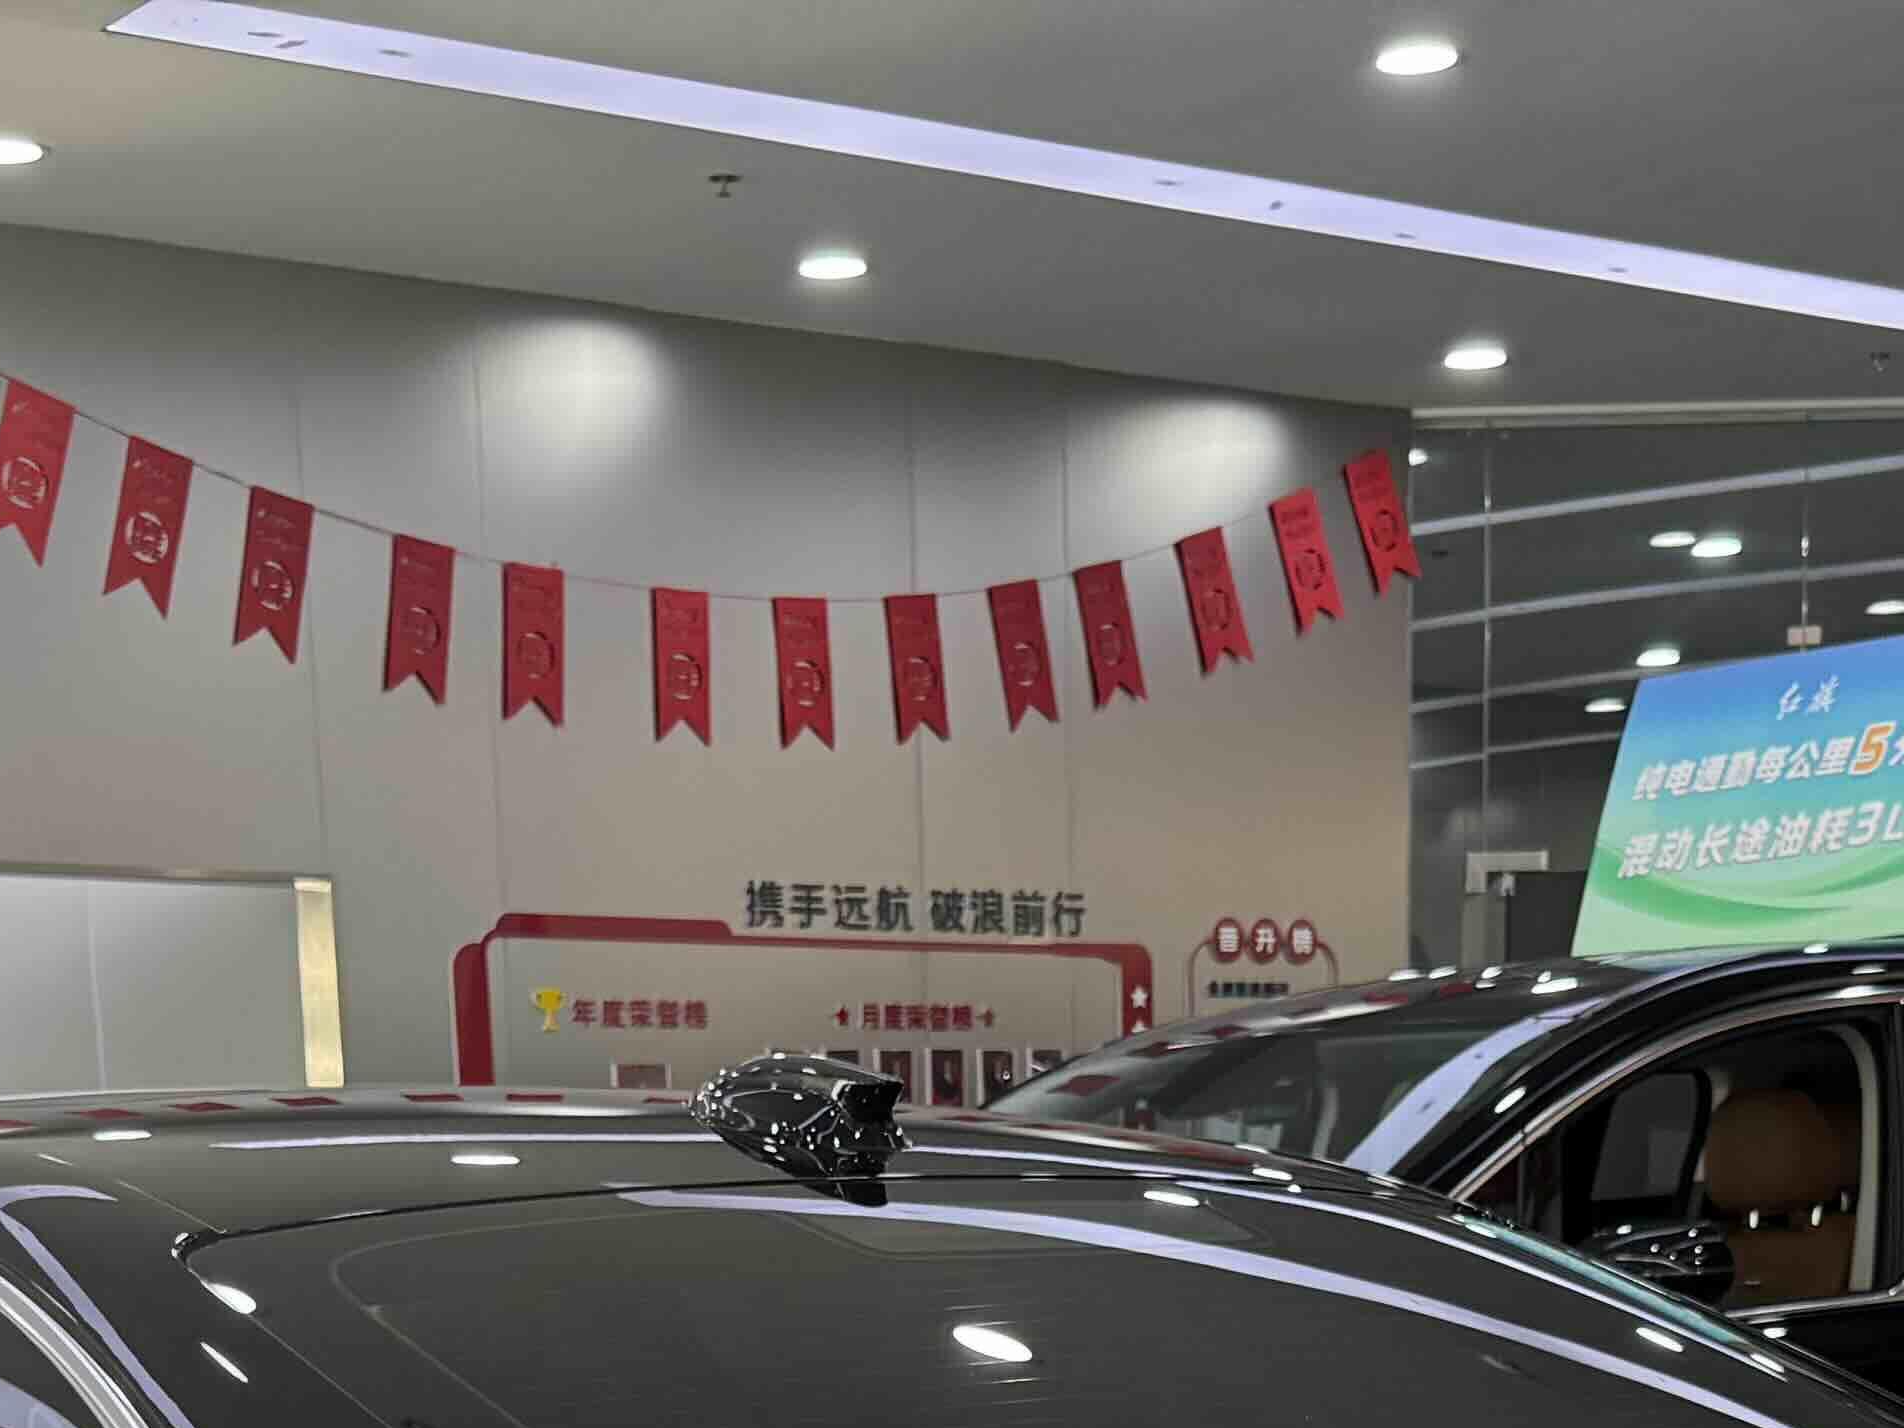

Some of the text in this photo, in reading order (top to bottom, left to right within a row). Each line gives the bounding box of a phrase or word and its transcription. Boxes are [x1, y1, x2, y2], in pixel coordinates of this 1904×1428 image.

[745, 877, 1087, 940] 携手远航 破浪前行
